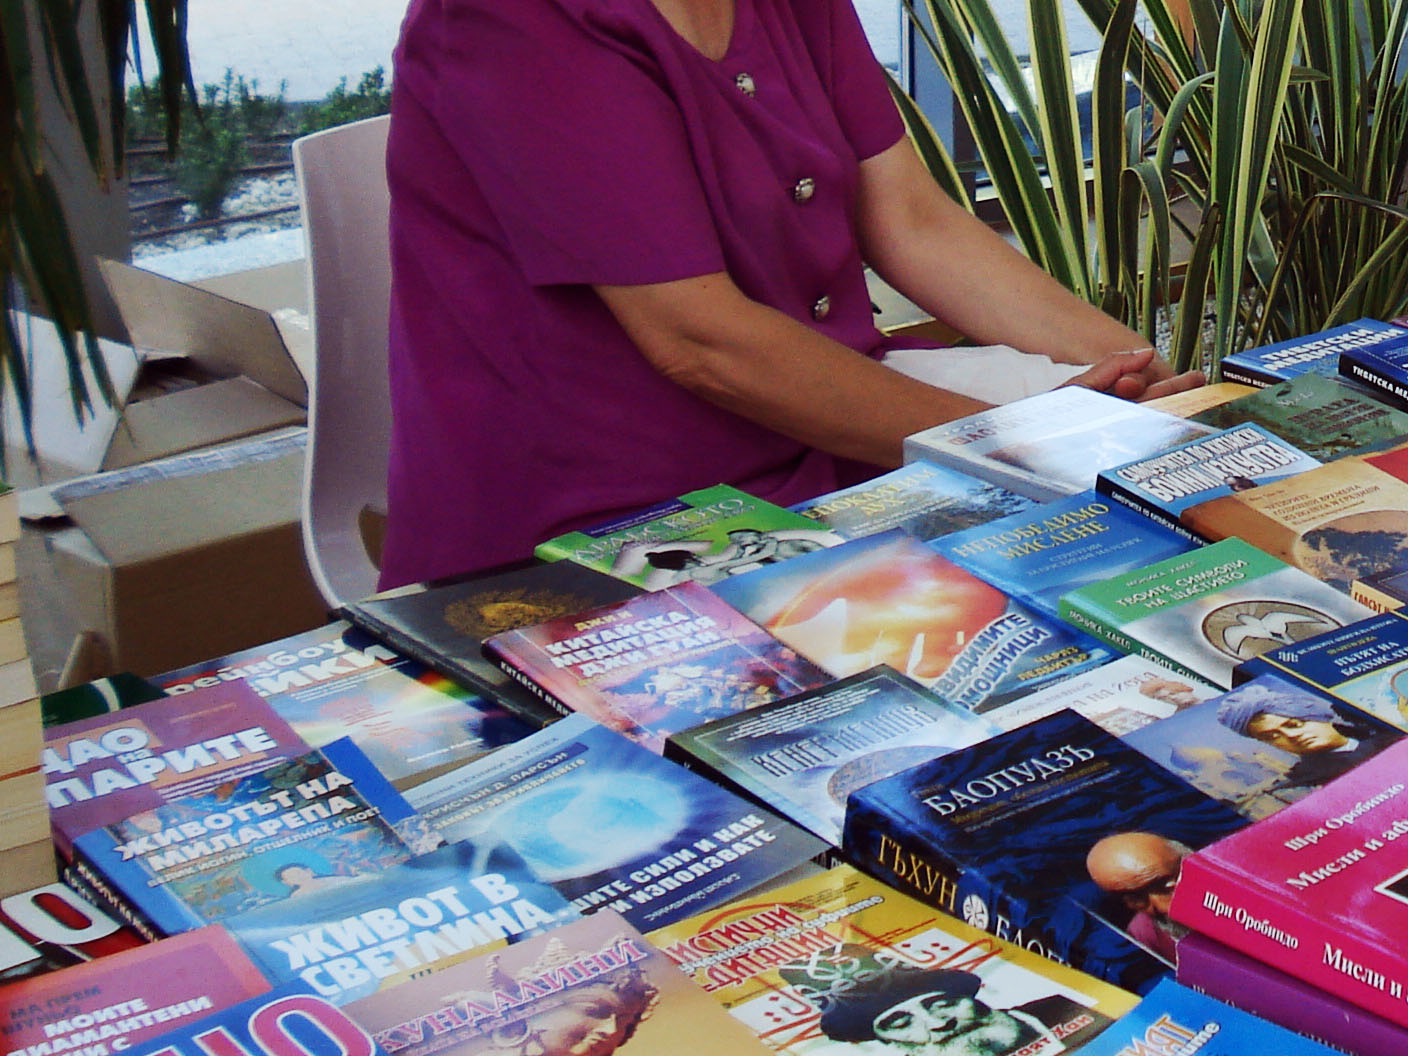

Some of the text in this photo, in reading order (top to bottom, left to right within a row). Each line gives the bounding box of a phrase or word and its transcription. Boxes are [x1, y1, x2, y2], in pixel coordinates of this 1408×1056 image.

[1353, 365, 1394, 392] ТИБЕТСКА
[1198, 441, 1301, 488] ИЗКУСТВА
[951, 502, 1110, 557] НЕПОБЕДИМО
[996, 520, 1110, 560] МИСЛЕНЕ
[1115, 584, 1173, 608] ТВОИТЕ
[1175, 559, 1249, 588] СИМВОЛИ
[1144, 571, 1246, 609] НА ЩАСТИЕТО
[545, 610, 691, 656] КИТАЙСКА
[550, 615, 718, 669] МЕДИТАЦИЯ
[45, 726, 279, 809] ПАРИТЕ
[922, 743, 1095, 816] БАОПУДЗЪ
[112, 790, 294, 862] ЖИВОТЪТ
[296, 771, 355, 800] НА
[147, 795, 357, 872] МИЛАРЕПА
[629, 848, 698, 884] СИЛИ
[693, 838, 718, 853] И
[713, 813, 766, 843] КАК
[1283, 782, 1406, 851] Шри Оробиндо
[629, 829, 778, 905] ИЗПОЛЗВАТЕ
[877, 834, 959, 913] ГЪХУН
[1286, 847, 1366, 890] Мисли
[1364, 837, 1384, 852] и
[269, 873, 519, 971] ЖИВОТ В
[299, 898, 557, 996] СВЕТЛИНА
[1202, 890, 1232, 918] Шри
[1234, 905, 1299, 950] Оробиндо
[1321, 942, 1387, 992] Мисли
[1390, 979, 1402, 999] и
[42, 997, 149, 1038] МОИТЕ
